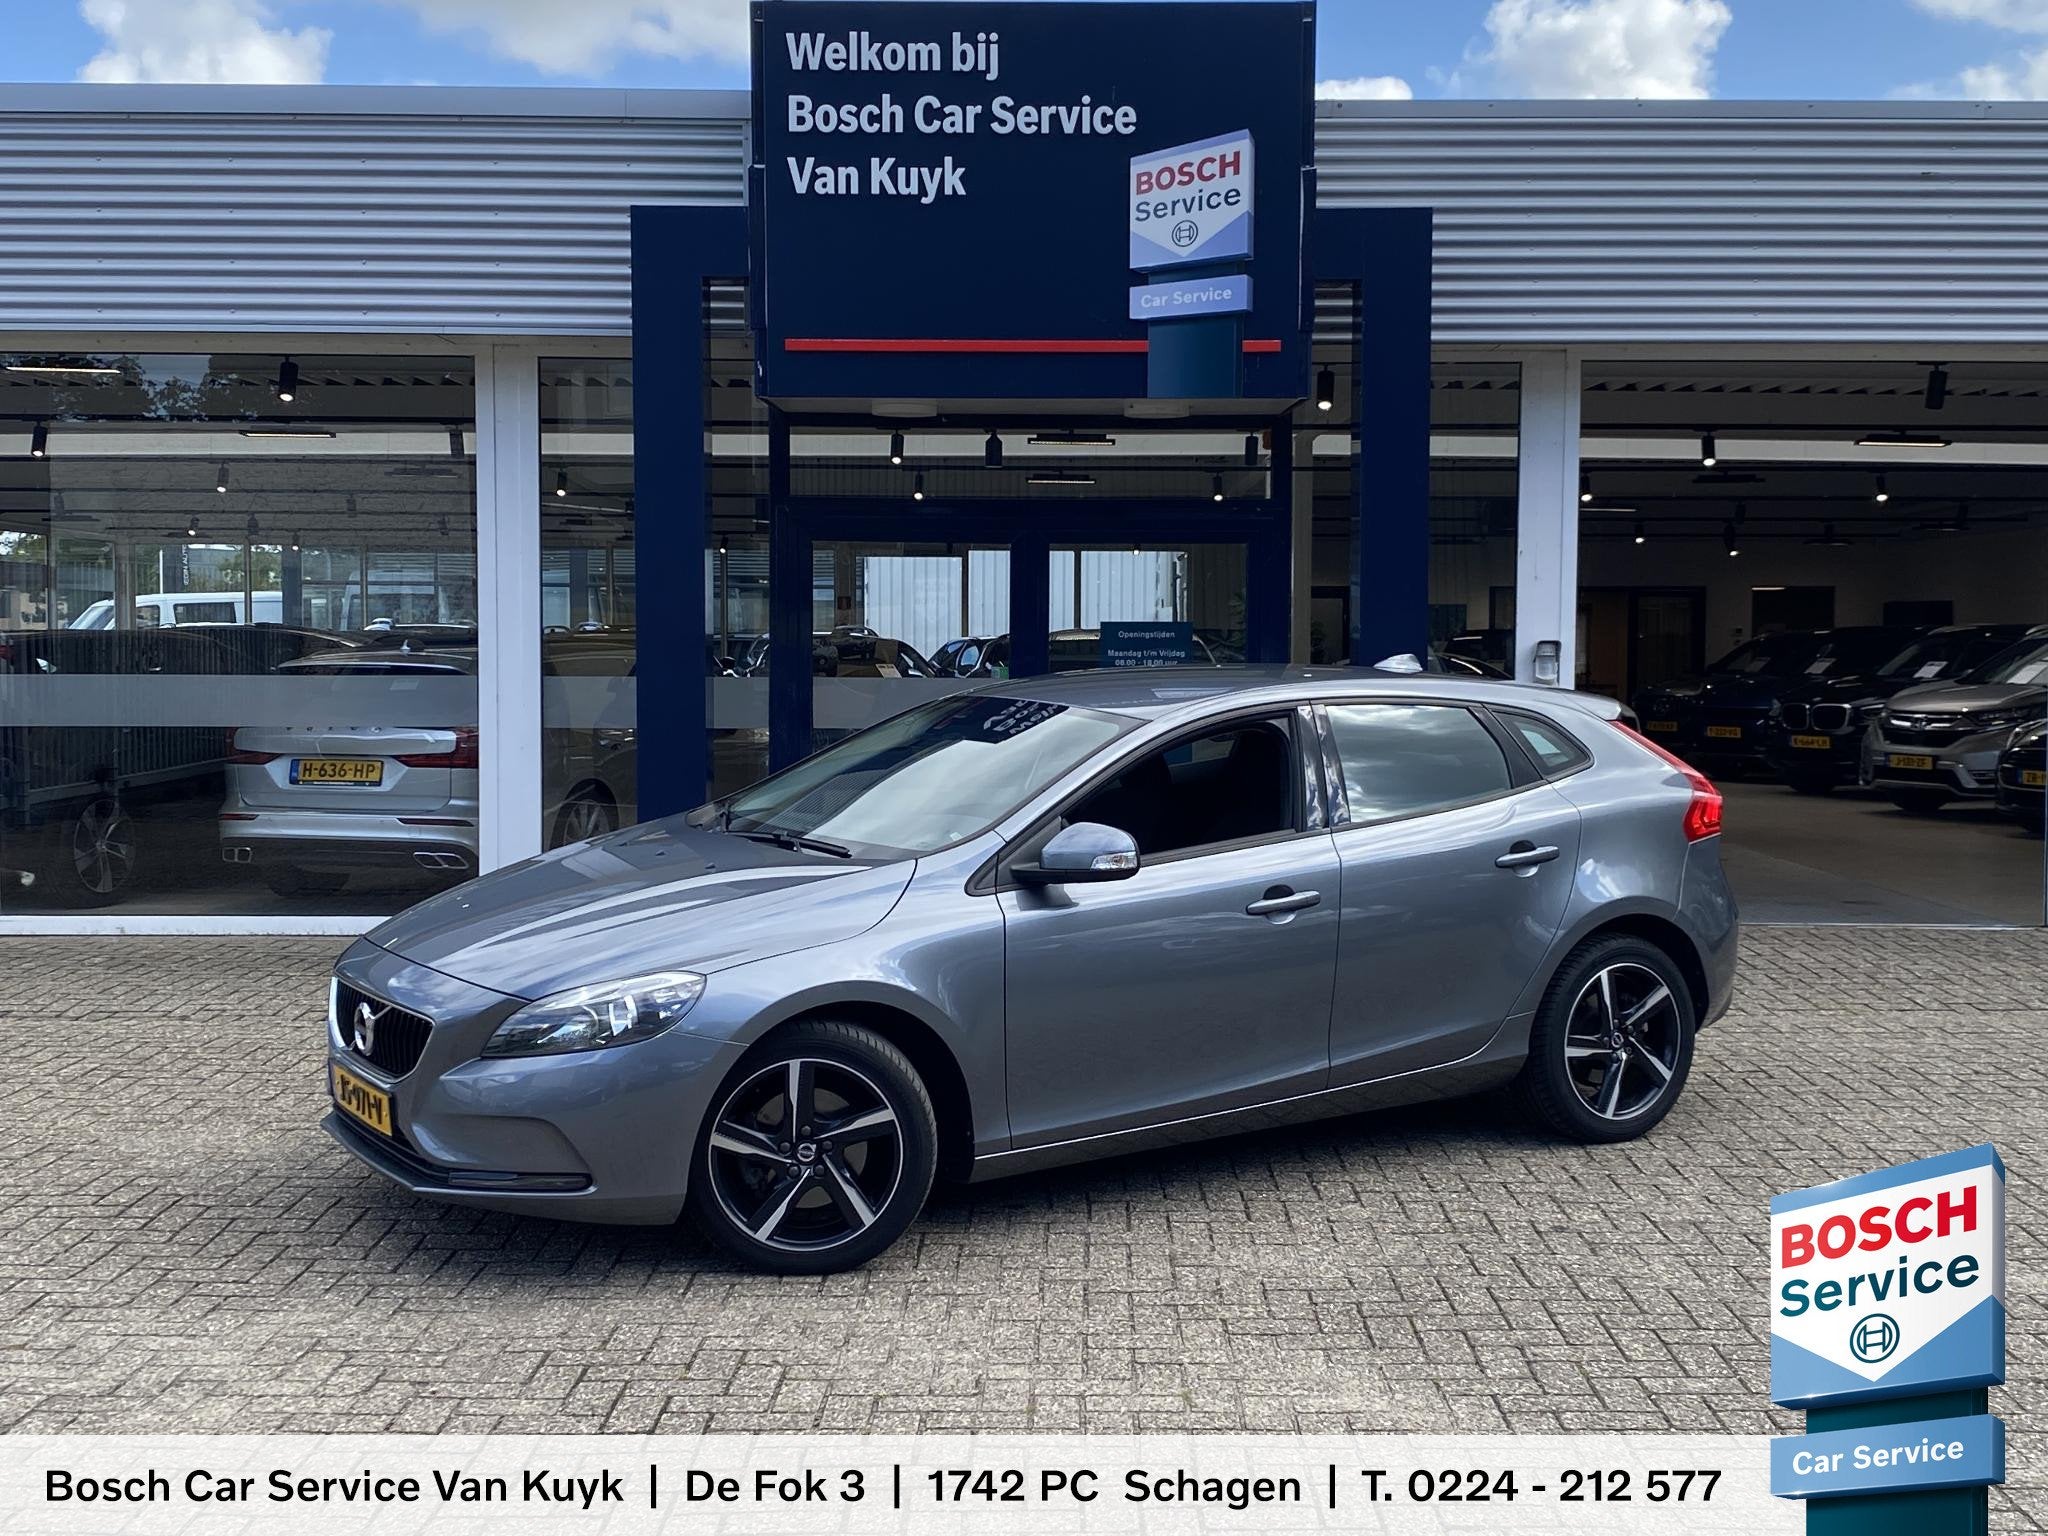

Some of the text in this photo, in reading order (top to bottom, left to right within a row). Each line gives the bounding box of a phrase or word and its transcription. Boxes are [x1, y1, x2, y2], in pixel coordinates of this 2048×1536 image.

[786, 31, 999, 81] Welkom bij
[788, 94, 1137, 135] Bosch Car Service
[787, 155, 967, 205] Van Kuyk
[1135, 150, 1241, 196] BOSCH
[1134, 187, 1242, 222] Service
[1140, 287, 1233, 308] Car Service
[1118, 630, 1176, 639] Openingstijden
[1107, 649, 1186, 658] Maandag t/m Vrijdag
[302, 762, 376, 778] H-636-HP
